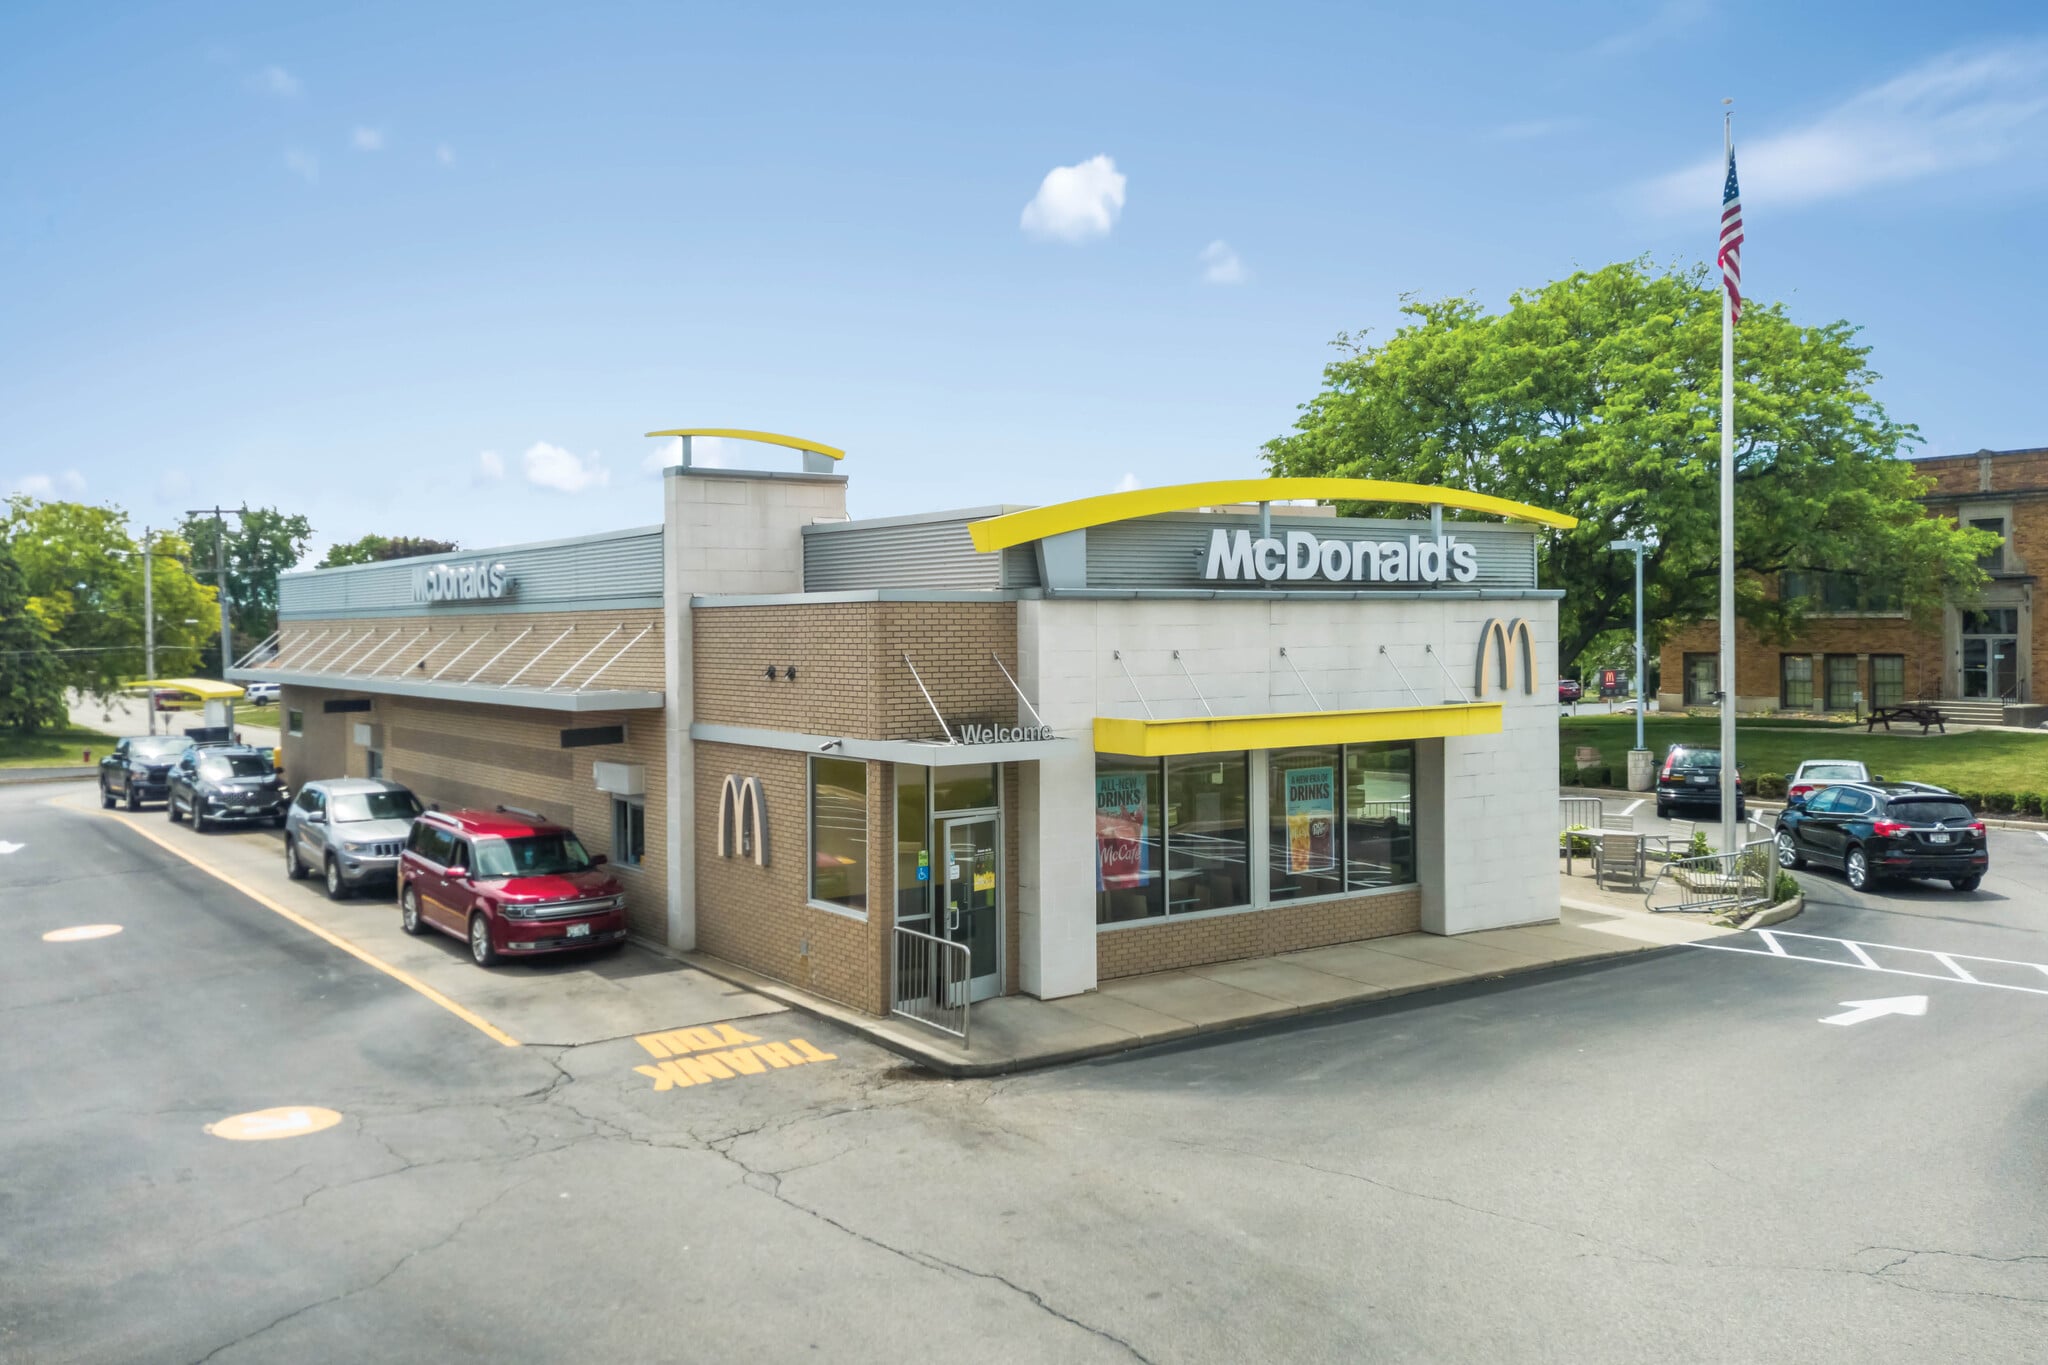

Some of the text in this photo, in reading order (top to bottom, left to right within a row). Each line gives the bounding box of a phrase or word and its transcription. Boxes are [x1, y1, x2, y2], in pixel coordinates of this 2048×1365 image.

[1205, 529, 1478, 582] McDonald's
[960, 723, 1053, 744] Welcome
[1101, 777, 1137, 791] ALL-NEW
[1290, 783, 1330, 801] DRINKS
[1098, 789, 1141, 808] DRINKS
[634, 1024, 763, 1059] YOU
[632, 1038, 838, 1091] THANK
